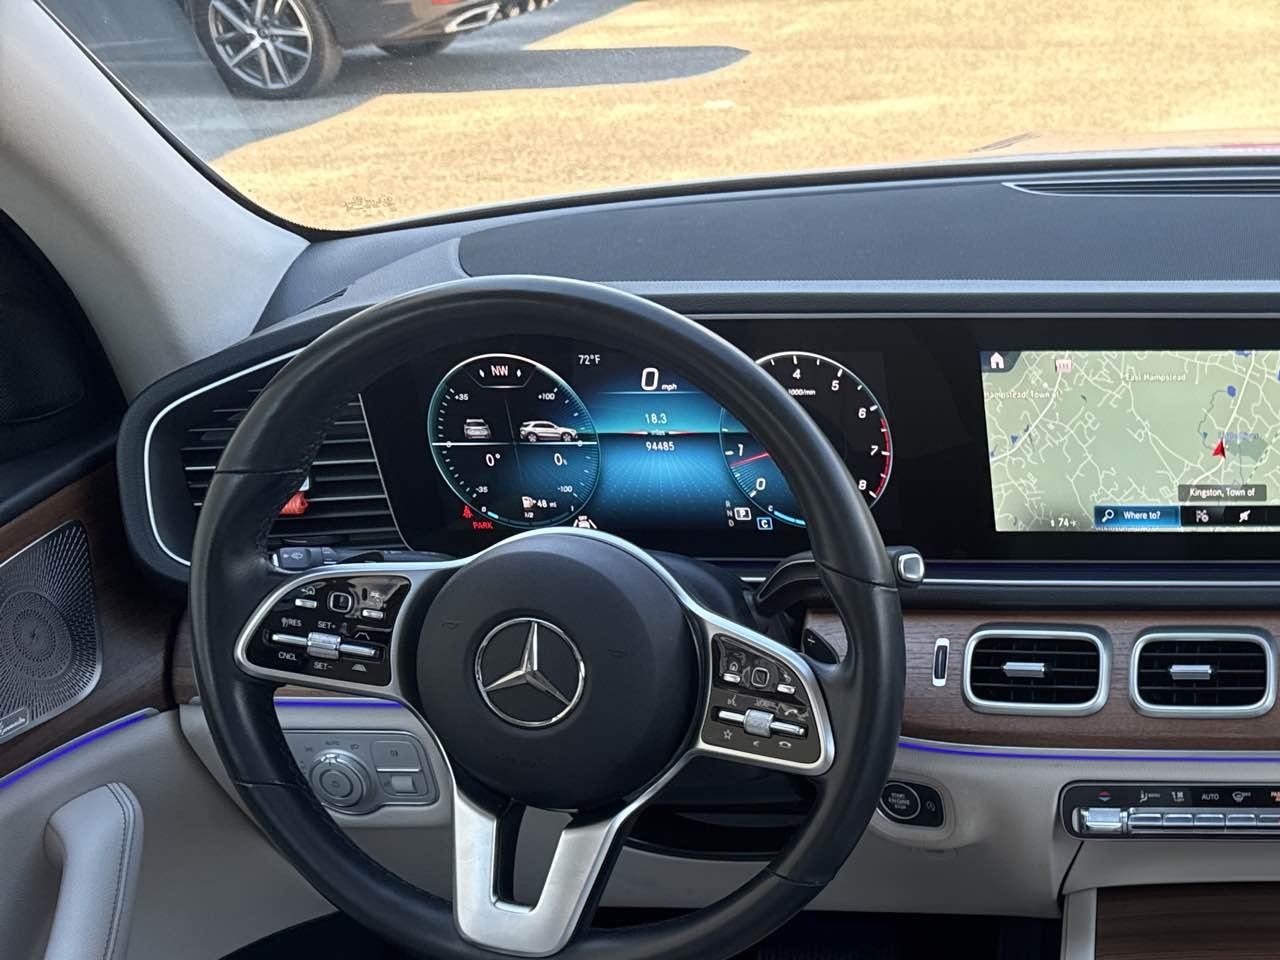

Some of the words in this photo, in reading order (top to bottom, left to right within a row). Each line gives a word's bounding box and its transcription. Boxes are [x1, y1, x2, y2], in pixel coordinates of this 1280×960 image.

[578, 354, 601, 365] 72°F
[490, 365, 509, 376] NW
[792, 369, 801, 379] 4
[661, 383, 677, 392] mph
[831, 380, 840, 391] 5
[644, 413, 668, 424] 18.3
[858, 408, 867, 419] 6
[645, 441, 675, 451] 94485
[737, 444, 743, 456] 1
[870, 446, 879, 455] 7
[756, 478, 766, 490] 0
[858, 480, 867, 490] 8
[1189, 487, 1225, 498] Kingston,
[1225, 488, 1245, 497] Town
[1246, 488, 1255, 497] of
[1123, 511, 1148, 520] Where
[1149, 511, 1161, 520] to?
[473, 521, 494, 530] PARK
[1201, 792, 1220, 801] AUTO
